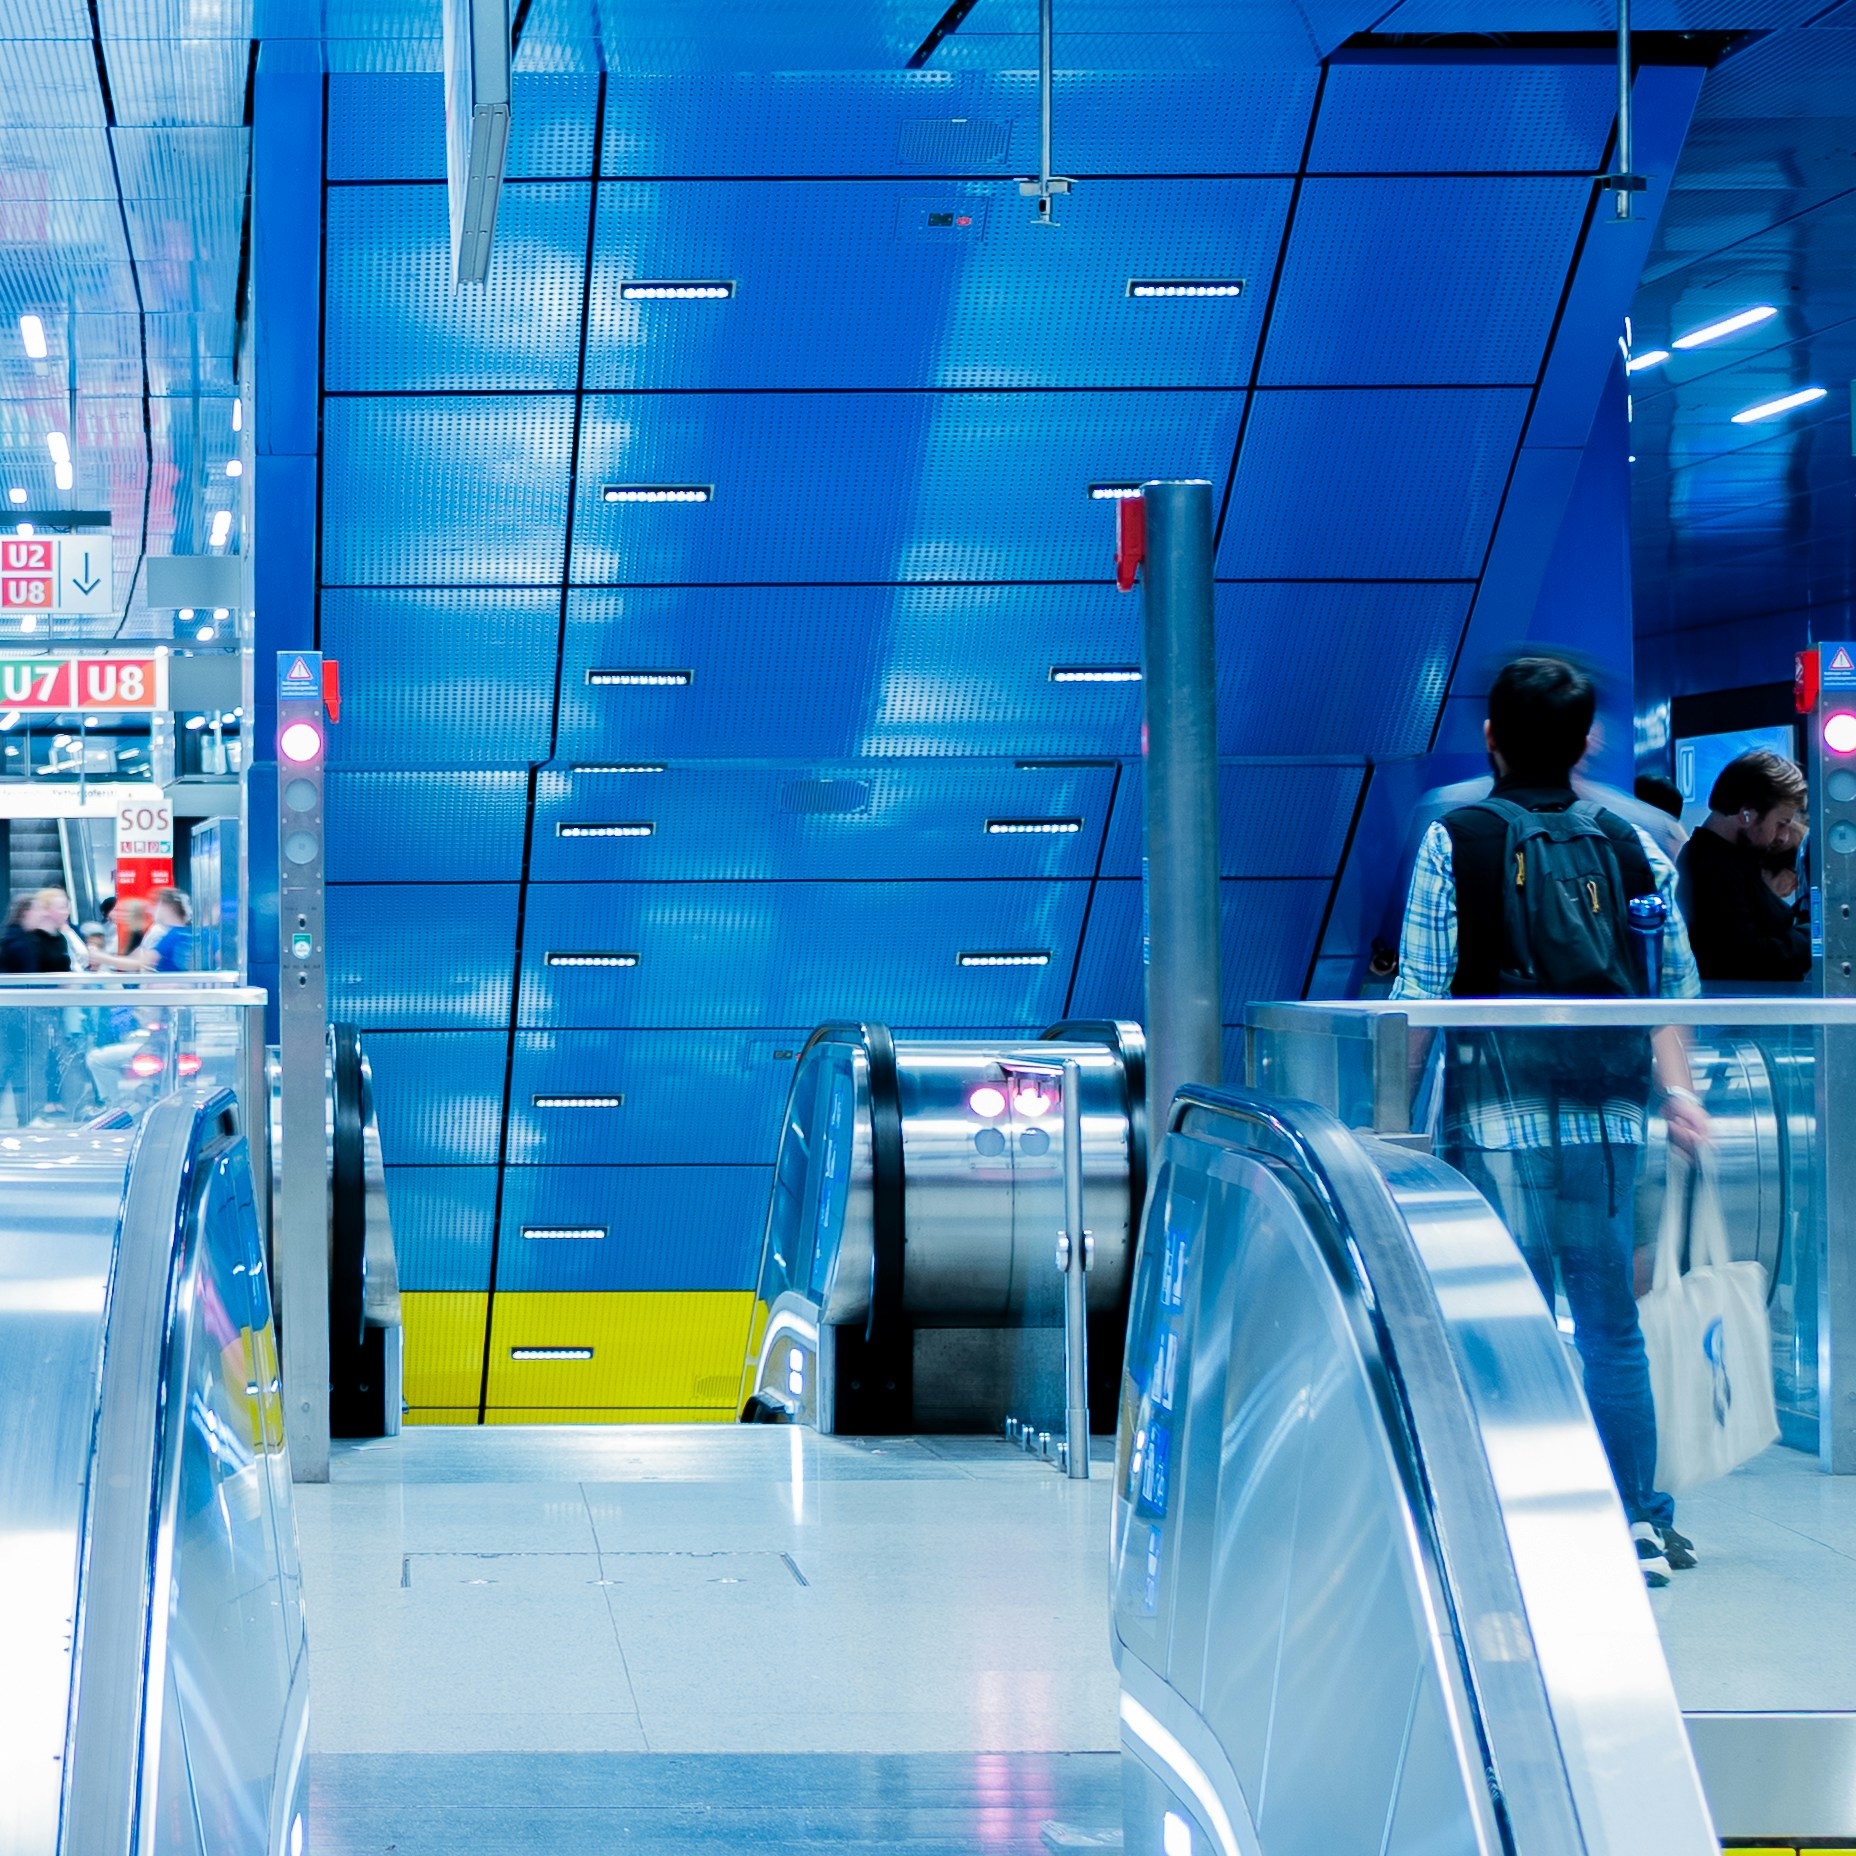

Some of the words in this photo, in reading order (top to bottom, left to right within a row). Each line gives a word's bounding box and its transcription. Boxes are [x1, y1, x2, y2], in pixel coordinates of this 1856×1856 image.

[8, 544, 45, 568] U2
[8, 580, 45, 605] U8
[3, 666, 60, 702] U7
[89, 665, 145, 702] U8
[121, 808, 169, 831] SOS
